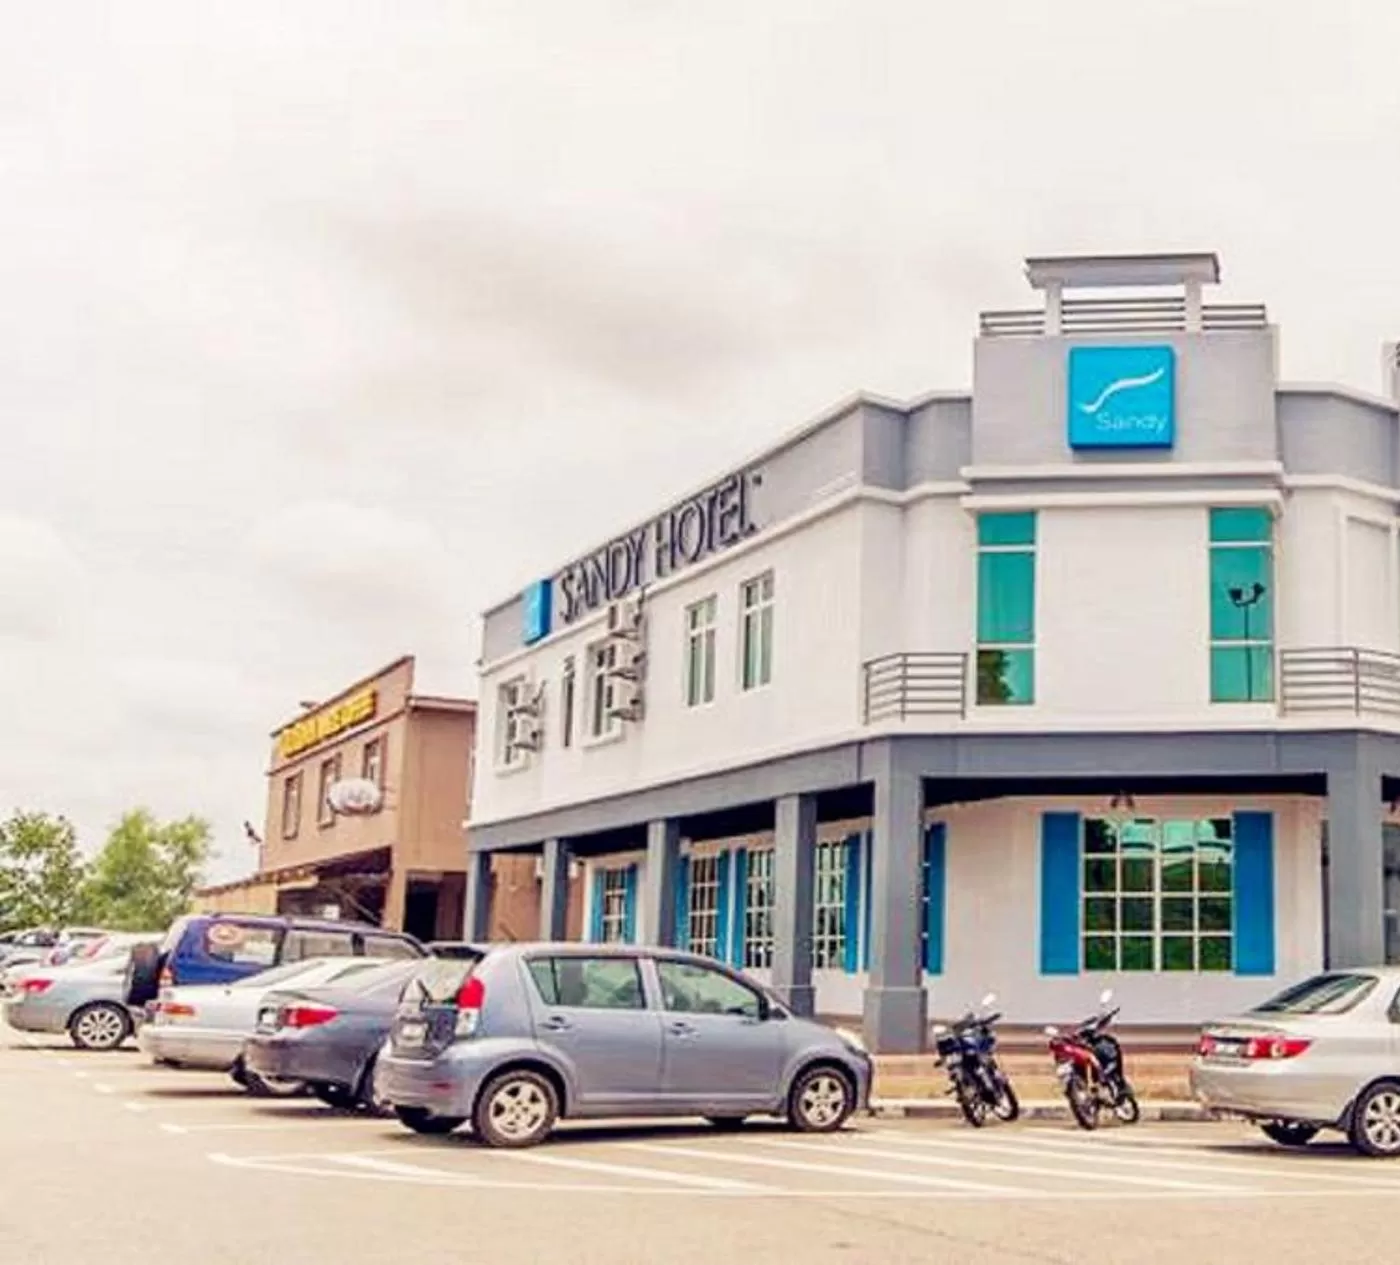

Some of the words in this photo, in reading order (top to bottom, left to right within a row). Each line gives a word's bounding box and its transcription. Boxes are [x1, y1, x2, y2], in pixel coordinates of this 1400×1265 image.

[1095, 410, 1168, 435] Sandy
[560, 530, 646, 624] SANDY
[656, 472, 756, 578] HOTEL
